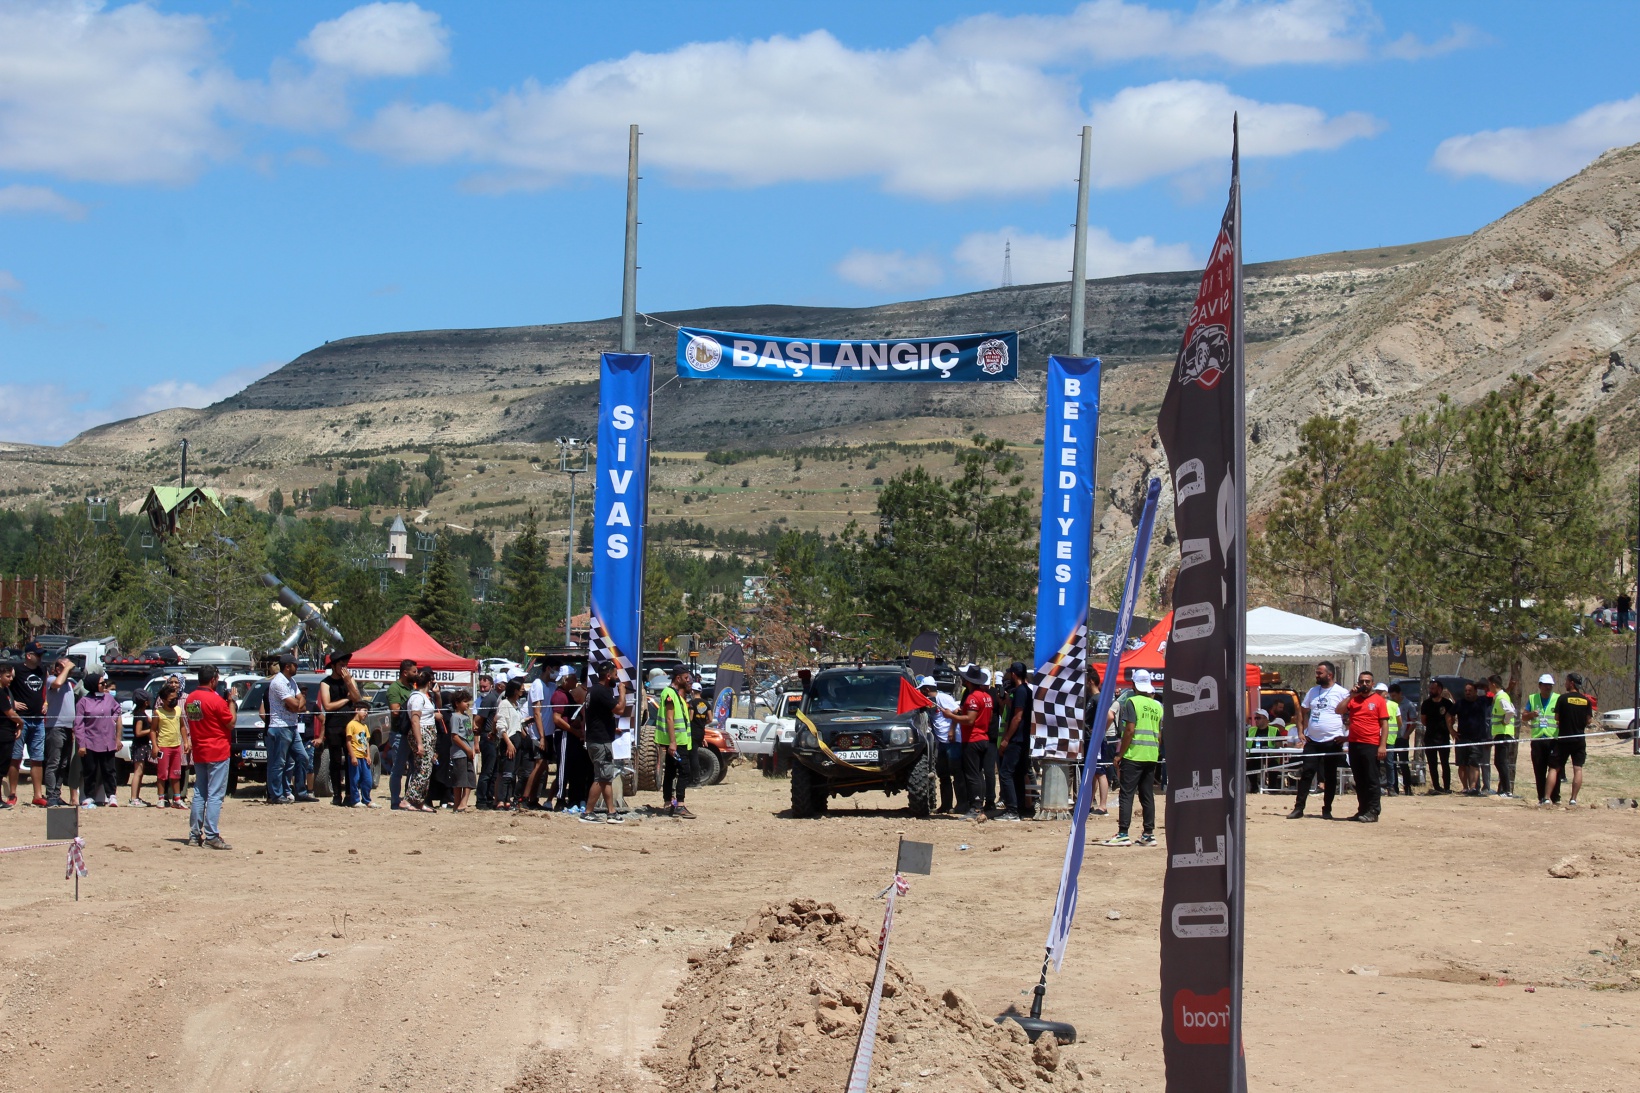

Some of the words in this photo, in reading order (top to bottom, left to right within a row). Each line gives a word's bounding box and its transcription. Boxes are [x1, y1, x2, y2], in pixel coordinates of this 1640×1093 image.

[733, 339, 960, 379] BAŞLANGIÇ
[850, 751, 862, 759] AN
[864, 751, 878, 759] 456
